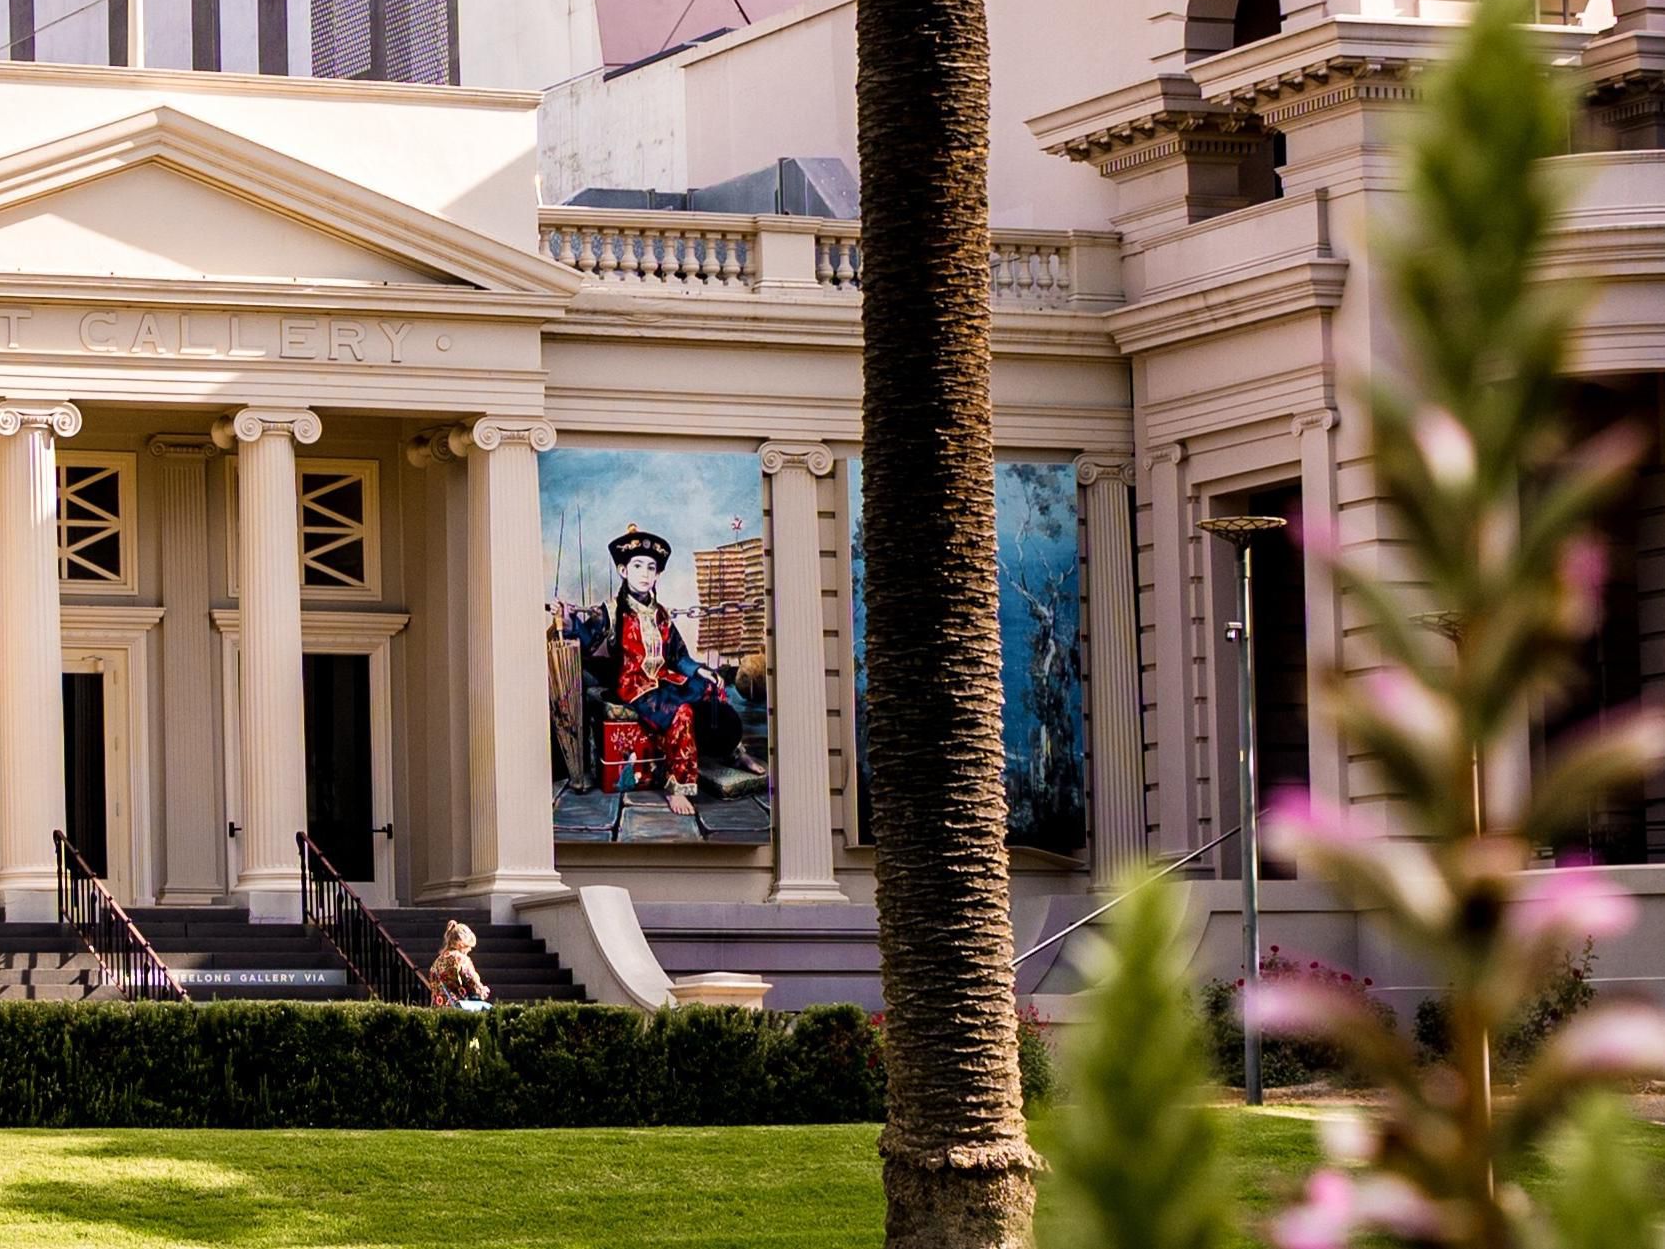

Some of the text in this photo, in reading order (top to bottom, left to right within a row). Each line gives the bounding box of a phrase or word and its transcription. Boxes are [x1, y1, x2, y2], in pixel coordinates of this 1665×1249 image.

[79, 310, 413, 363] GALLERY
[239, 973, 296, 983] GALLERY
[303, 973, 327, 983] VIA
